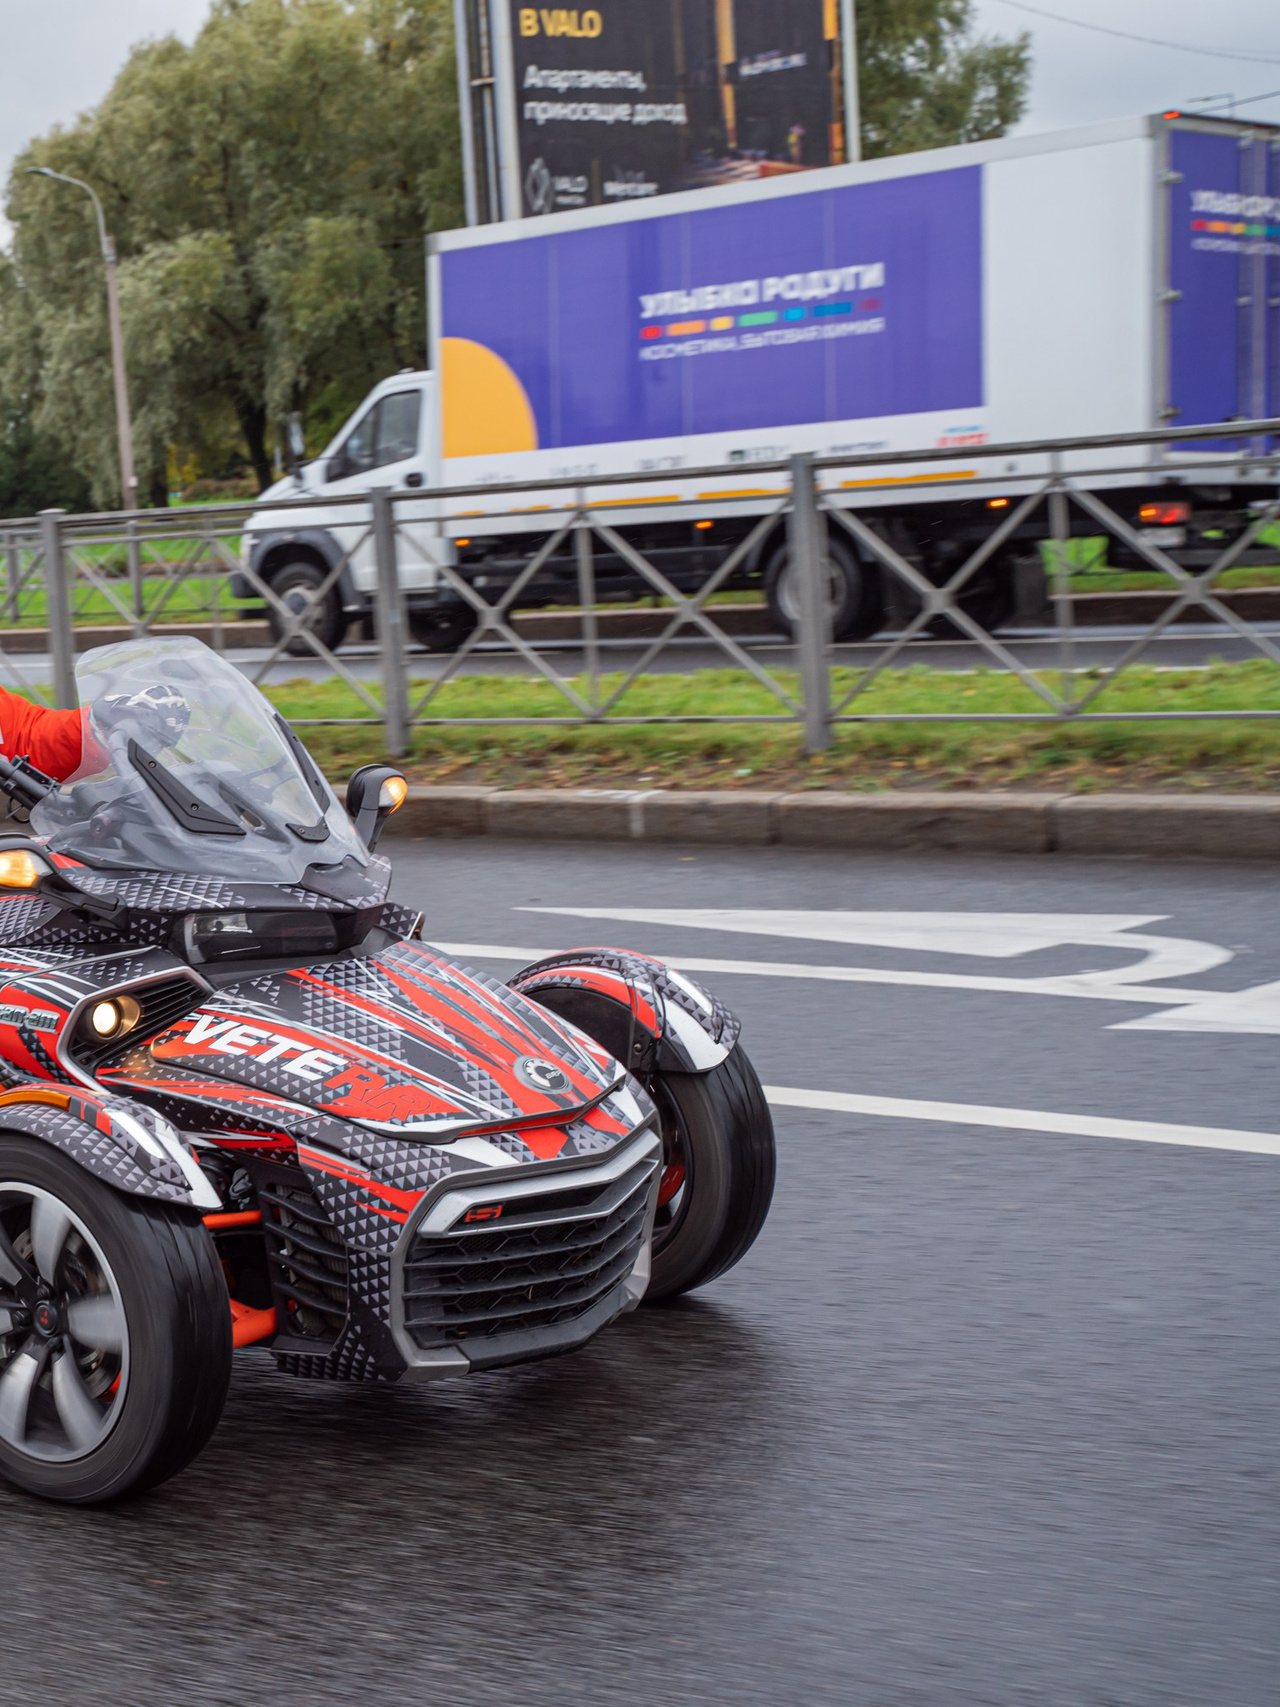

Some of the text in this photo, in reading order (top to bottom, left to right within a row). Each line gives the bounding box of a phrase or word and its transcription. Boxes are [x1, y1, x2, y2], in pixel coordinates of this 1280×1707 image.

[540, 9, 602, 37] VALO
[524, 102, 687, 124] приносящие доход
